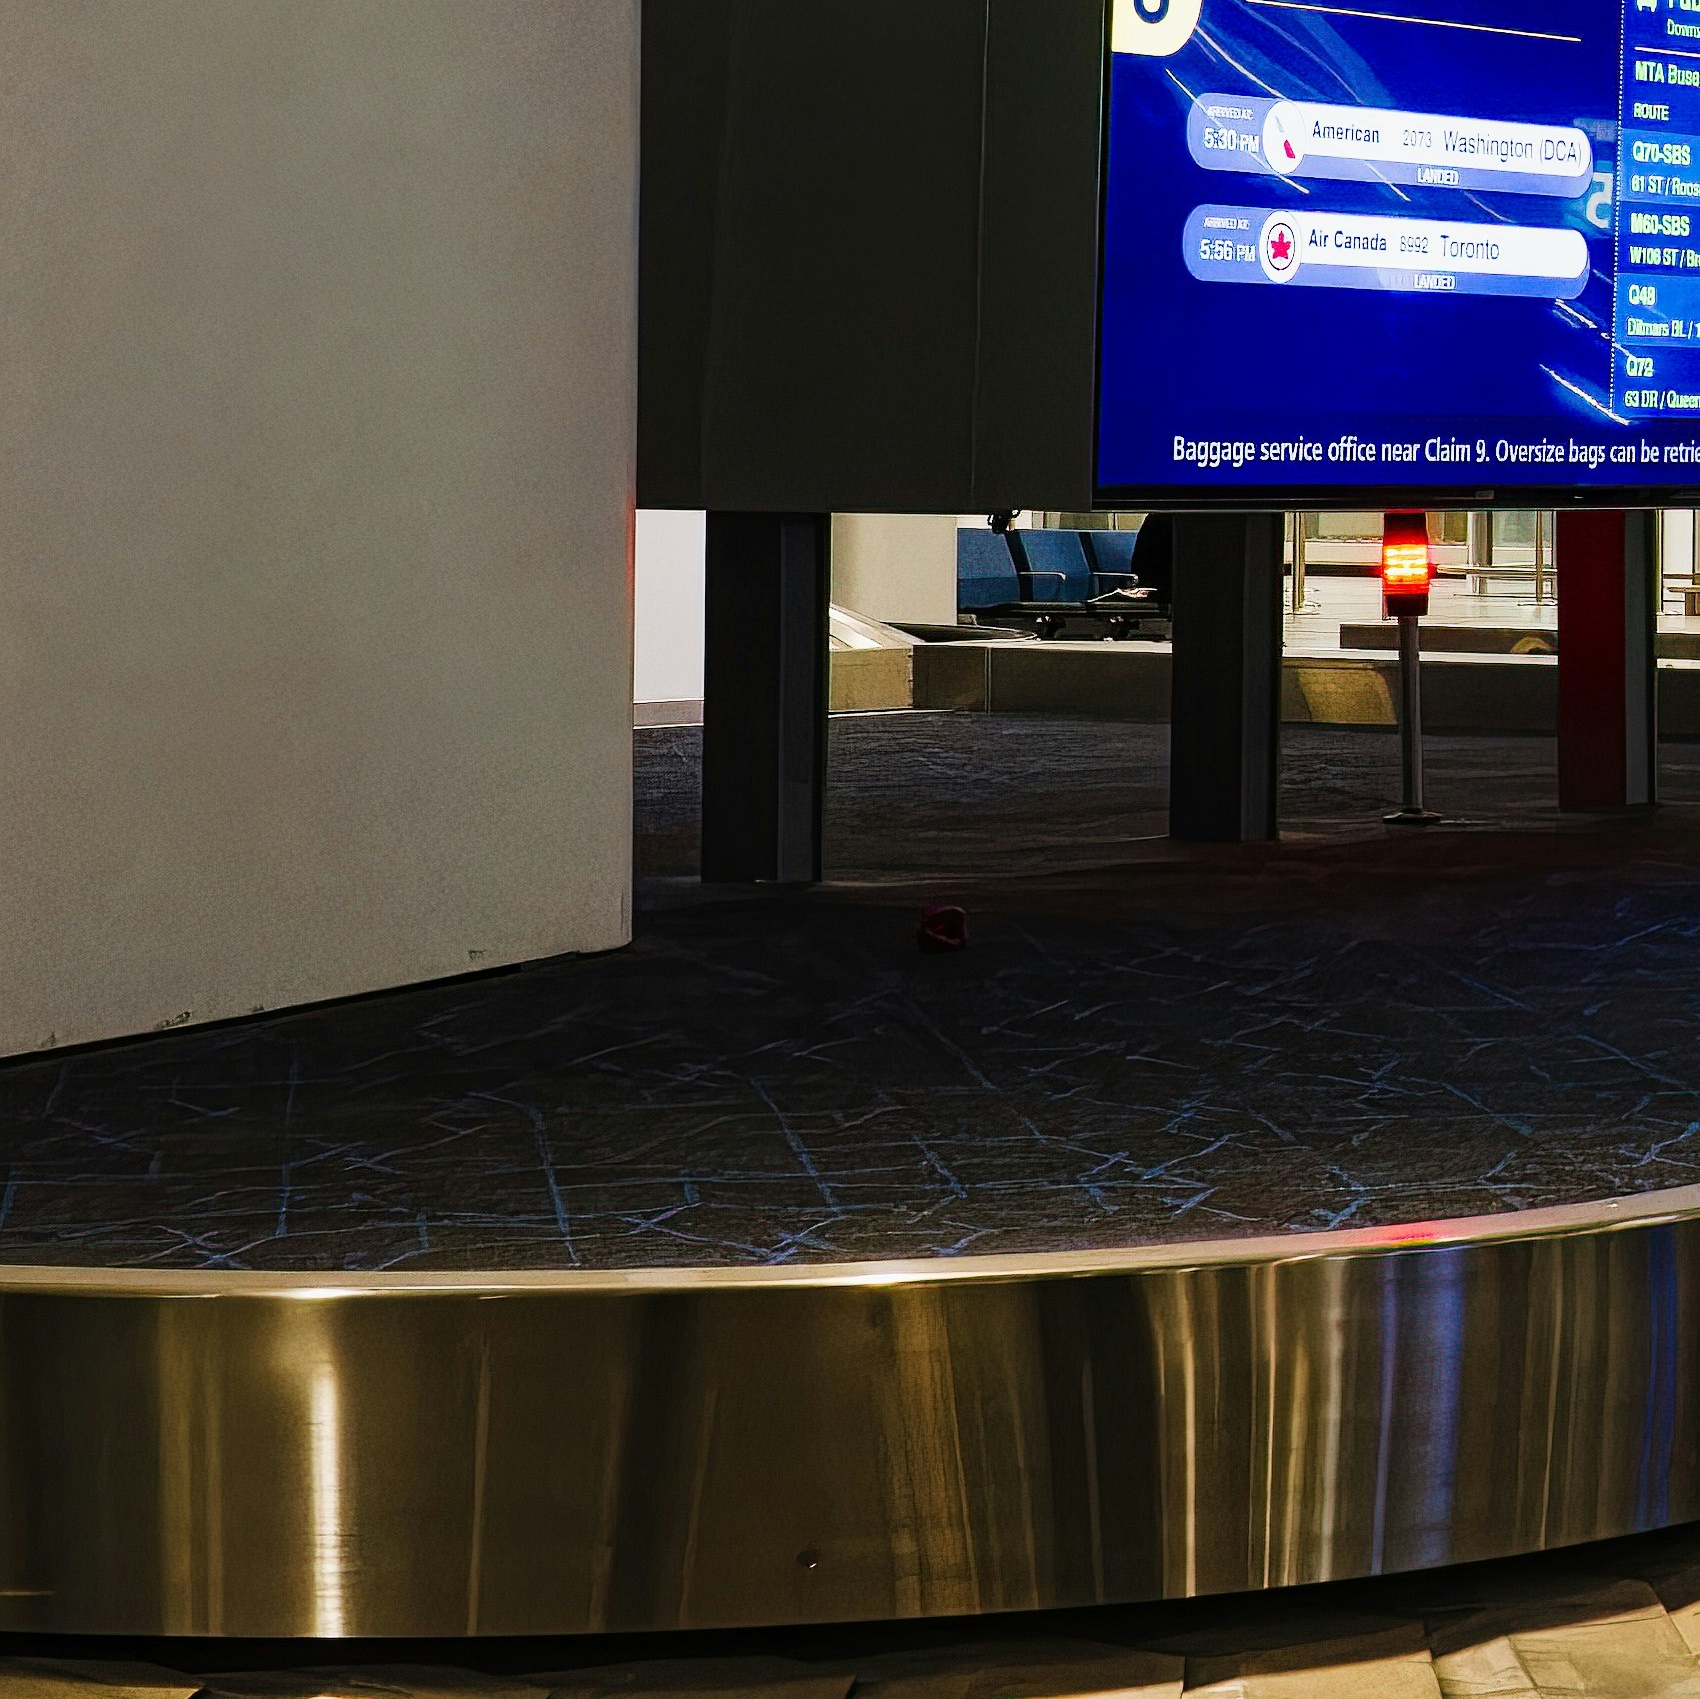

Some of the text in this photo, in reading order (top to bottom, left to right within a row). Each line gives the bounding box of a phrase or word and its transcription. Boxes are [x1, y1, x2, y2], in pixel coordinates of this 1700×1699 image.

[1635, 60, 1665, 84] MTA
[1633, 102, 1670, 121] ROUTE
[1203, 127, 1260, 153] 5:30 PM
[1312, 120, 1582, 168] American 2073 Washington (DCA)
[1632, 140, 1691, 166] Q70-SBS
[1417, 166, 1459, 185] LANDED
[1647, 175, 1665, 194] ST
[1630, 212, 1691, 236] M60-SBS
[1199, 238, 1256, 262] 5:56 PM
[1309, 228, 1329, 248] Air
[1334, 230, 1387, 251] Canada
[1440, 234, 1500, 260] Toronto
[1662, 248, 1679, 267] ST
[1626, 356, 1655, 377] Q72
[1641, 390, 1658, 409] DR
[1173, 435, 1255, 468] Baggage
[1259, 435, 1323, 462] service
[1327, 435, 1376, 462] office
[1381, 442, 1420, 462] near
[1425, 436, 1471, 462] Claim
[1475, 439, 1490, 463] 9.
[1495, 437, 1565, 463] Oversize
[1569, 438, 1606, 469] bags
[1609, 444, 1636, 463] can
[1641, 438, 1660, 463] be
